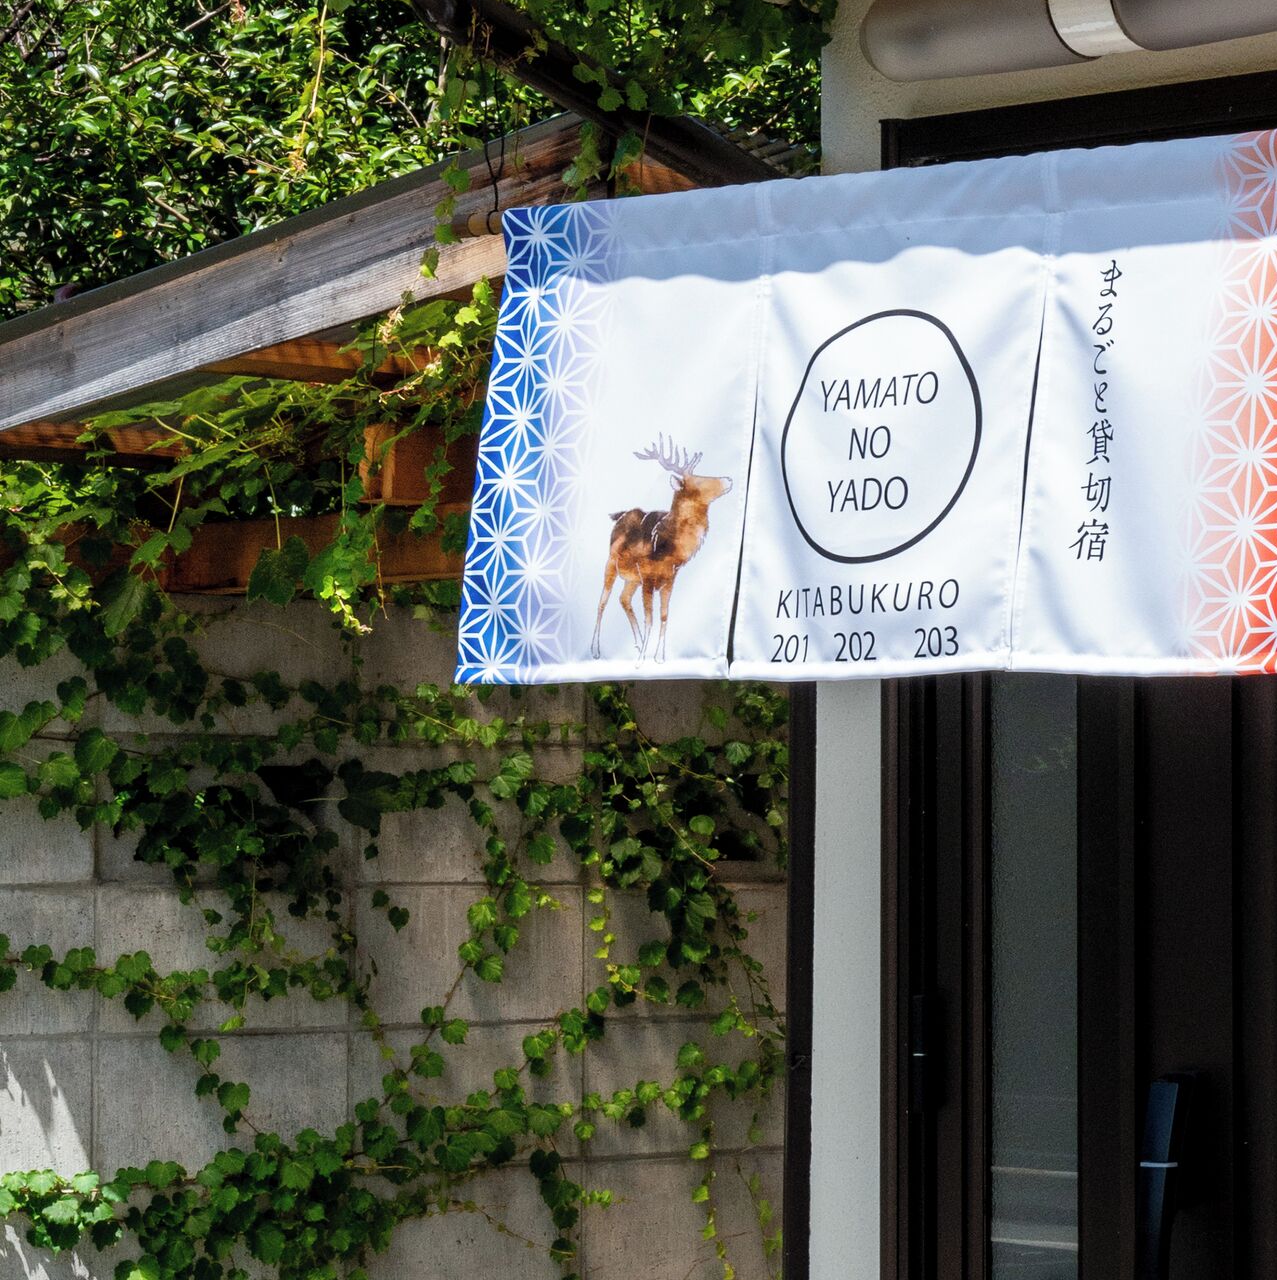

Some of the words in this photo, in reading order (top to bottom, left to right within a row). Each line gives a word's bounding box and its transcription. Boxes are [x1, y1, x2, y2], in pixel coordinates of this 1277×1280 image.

[820, 371, 939, 412] YAMATO
[1068, 259, 1122, 562] まるごと貸切宿
[848, 425, 891, 460] NO
[827, 476, 908, 512] YADO
[776, 578, 959, 618] KITABUKURO
[770, 634, 809, 662] 201
[833, 631, 877, 662] 202
[914, 625, 959, 658] 203
